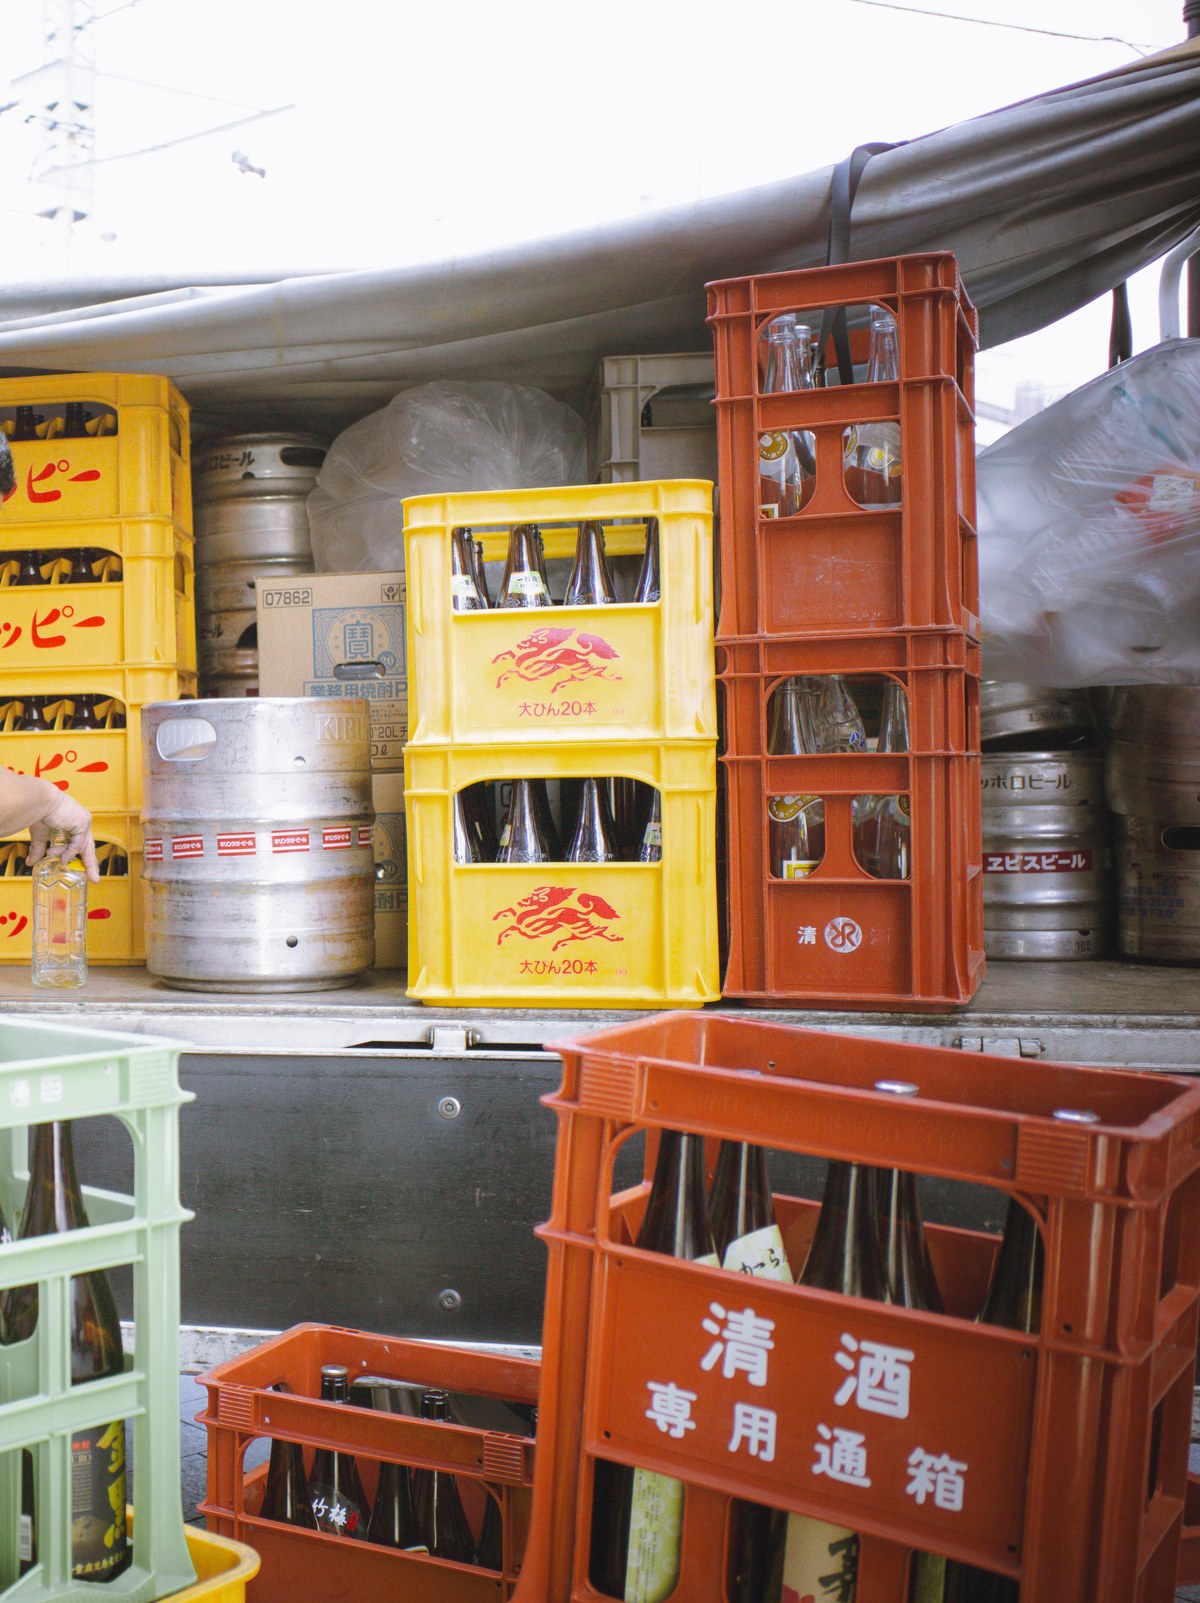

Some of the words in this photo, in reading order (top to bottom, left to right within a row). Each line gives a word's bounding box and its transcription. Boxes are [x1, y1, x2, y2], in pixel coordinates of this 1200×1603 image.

[2, 459, 101, 503] ピー
[265, 590, 310, 606] 07862
[518, 701, 597, 717] 大びん20本
[7, 750, 109, 791] ピー
[520, 959, 599, 974] 大びん20本
[700, 1301, 915, 1419] 清酒
[645, 1380, 968, 1512] 専用通箱
